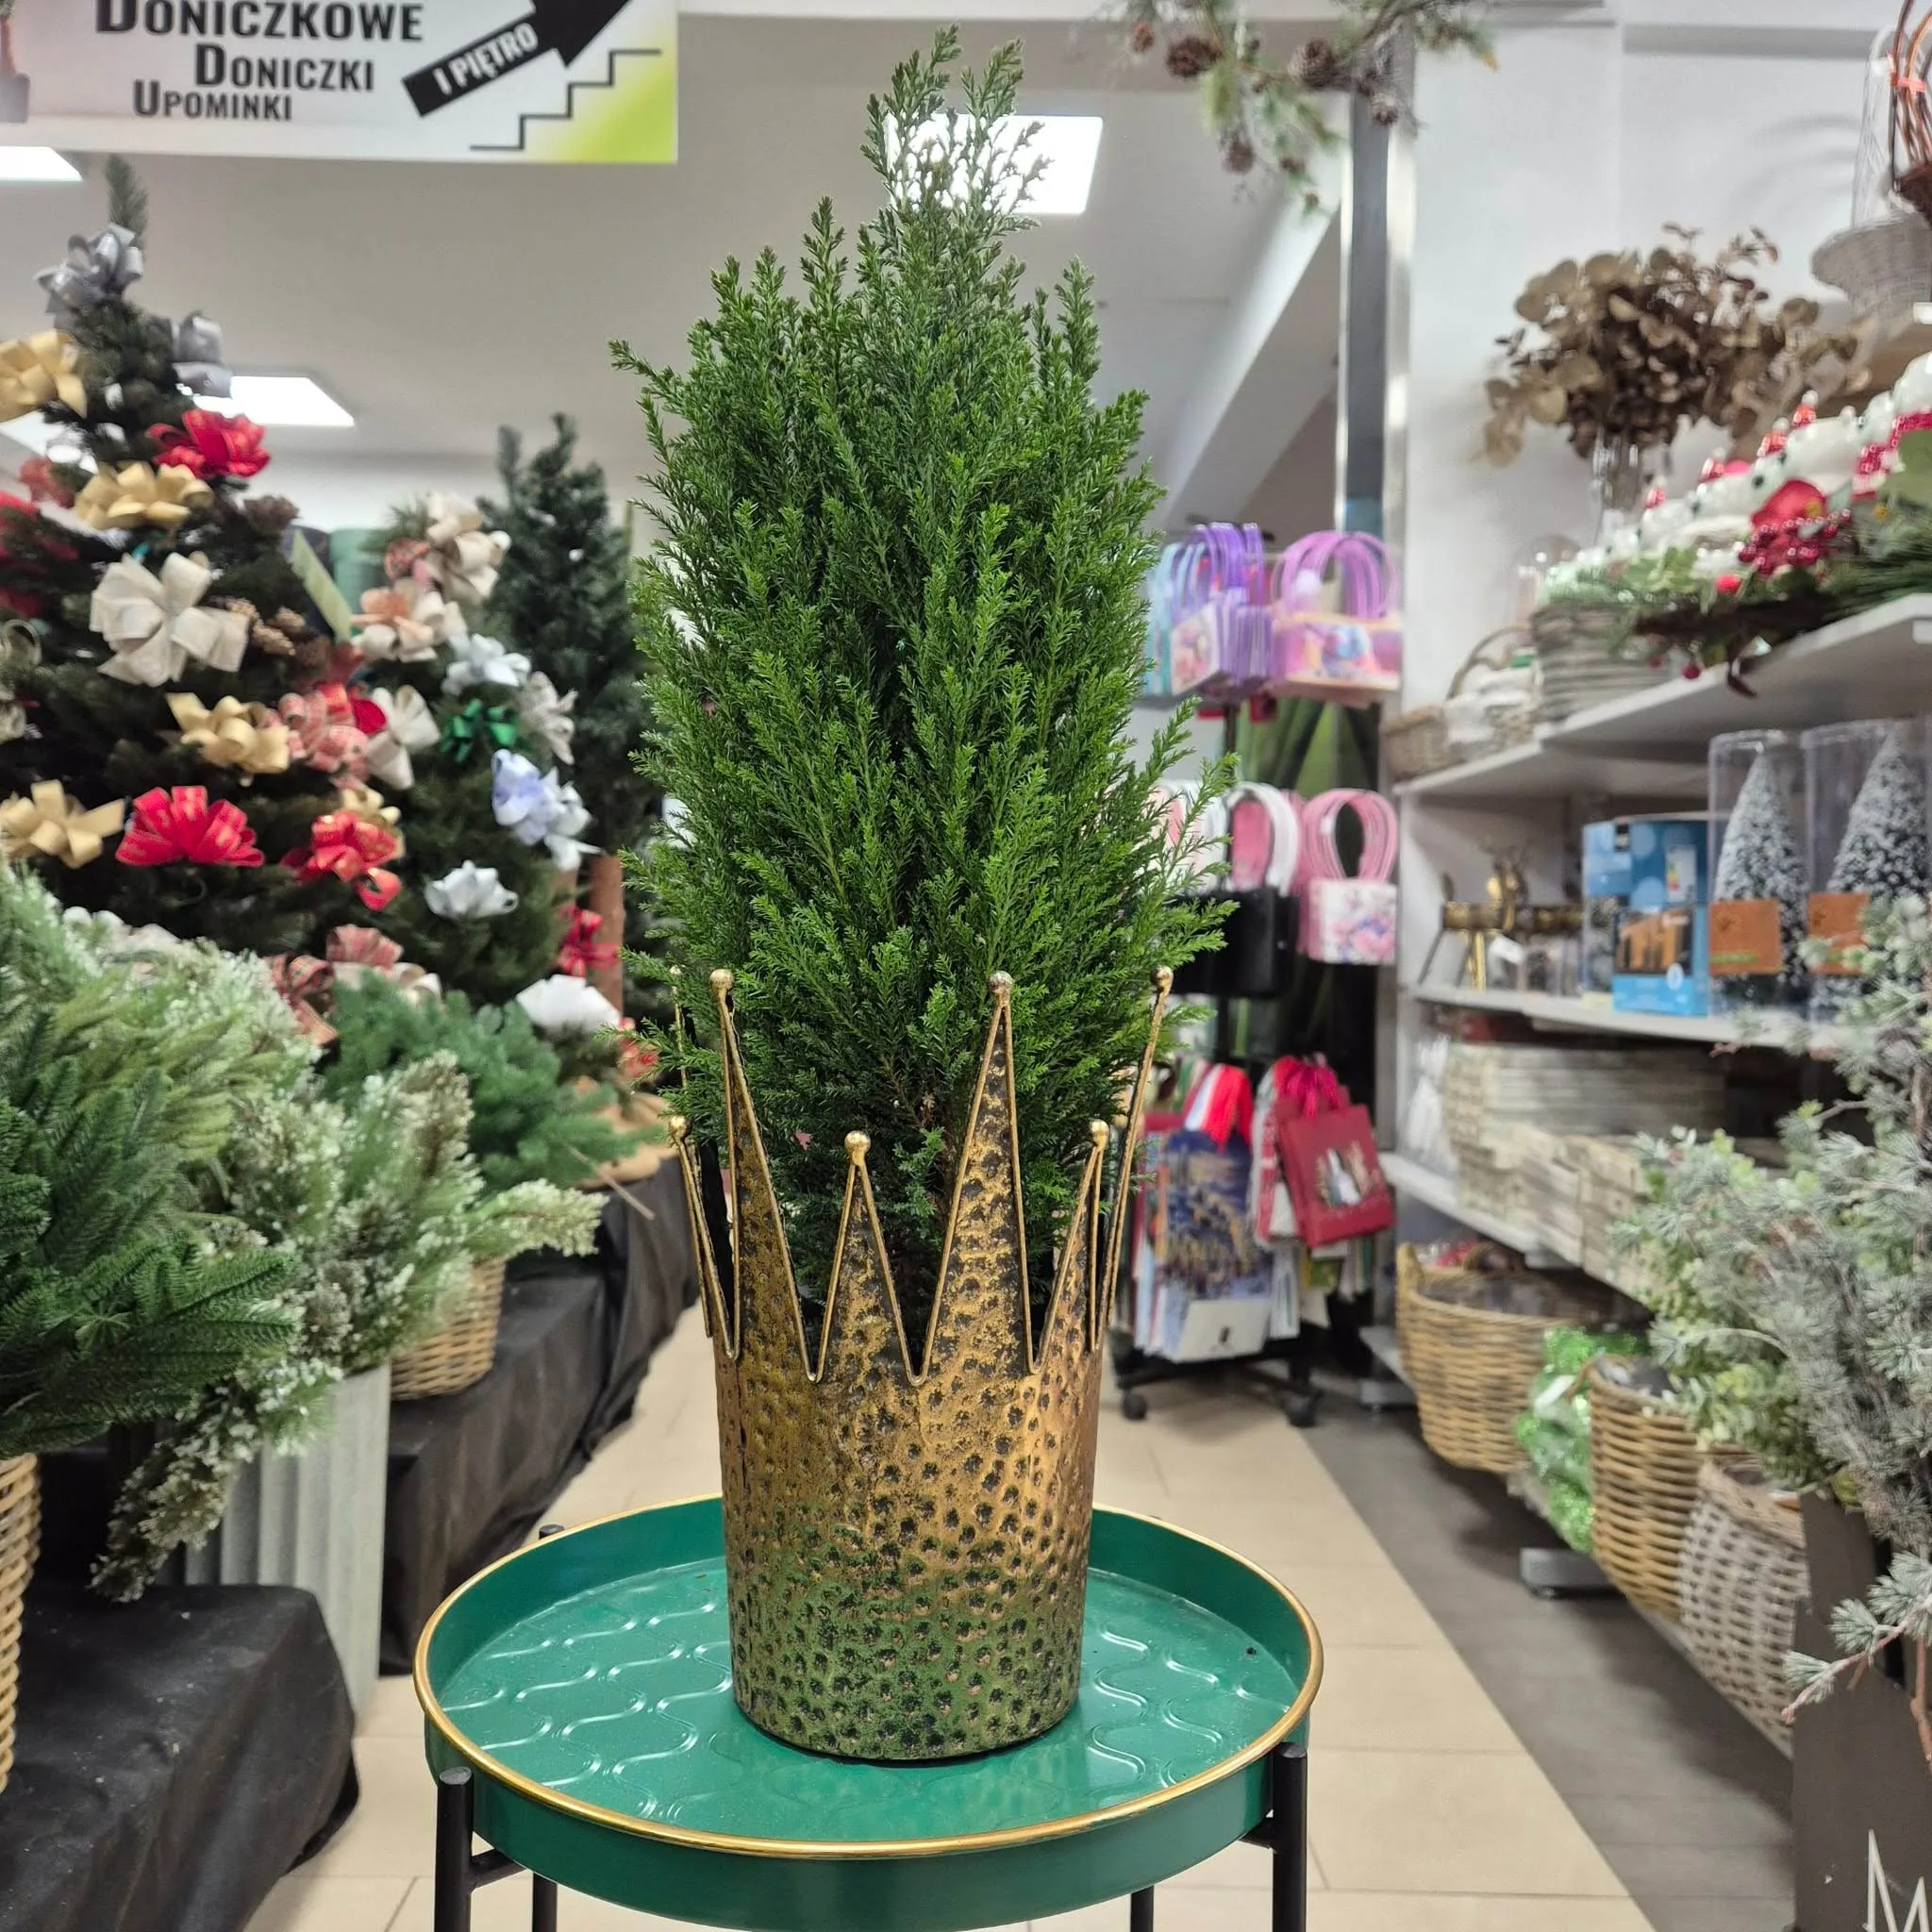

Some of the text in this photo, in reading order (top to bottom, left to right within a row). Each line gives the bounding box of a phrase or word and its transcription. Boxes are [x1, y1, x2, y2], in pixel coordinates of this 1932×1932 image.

[96, 0, 424, 41] DONICZKOWE
[195, 43, 374, 91] DONICZKI
[448, 23, 539, 88] PIĘTRO
[133, 79, 292, 121] UPOMINKI
